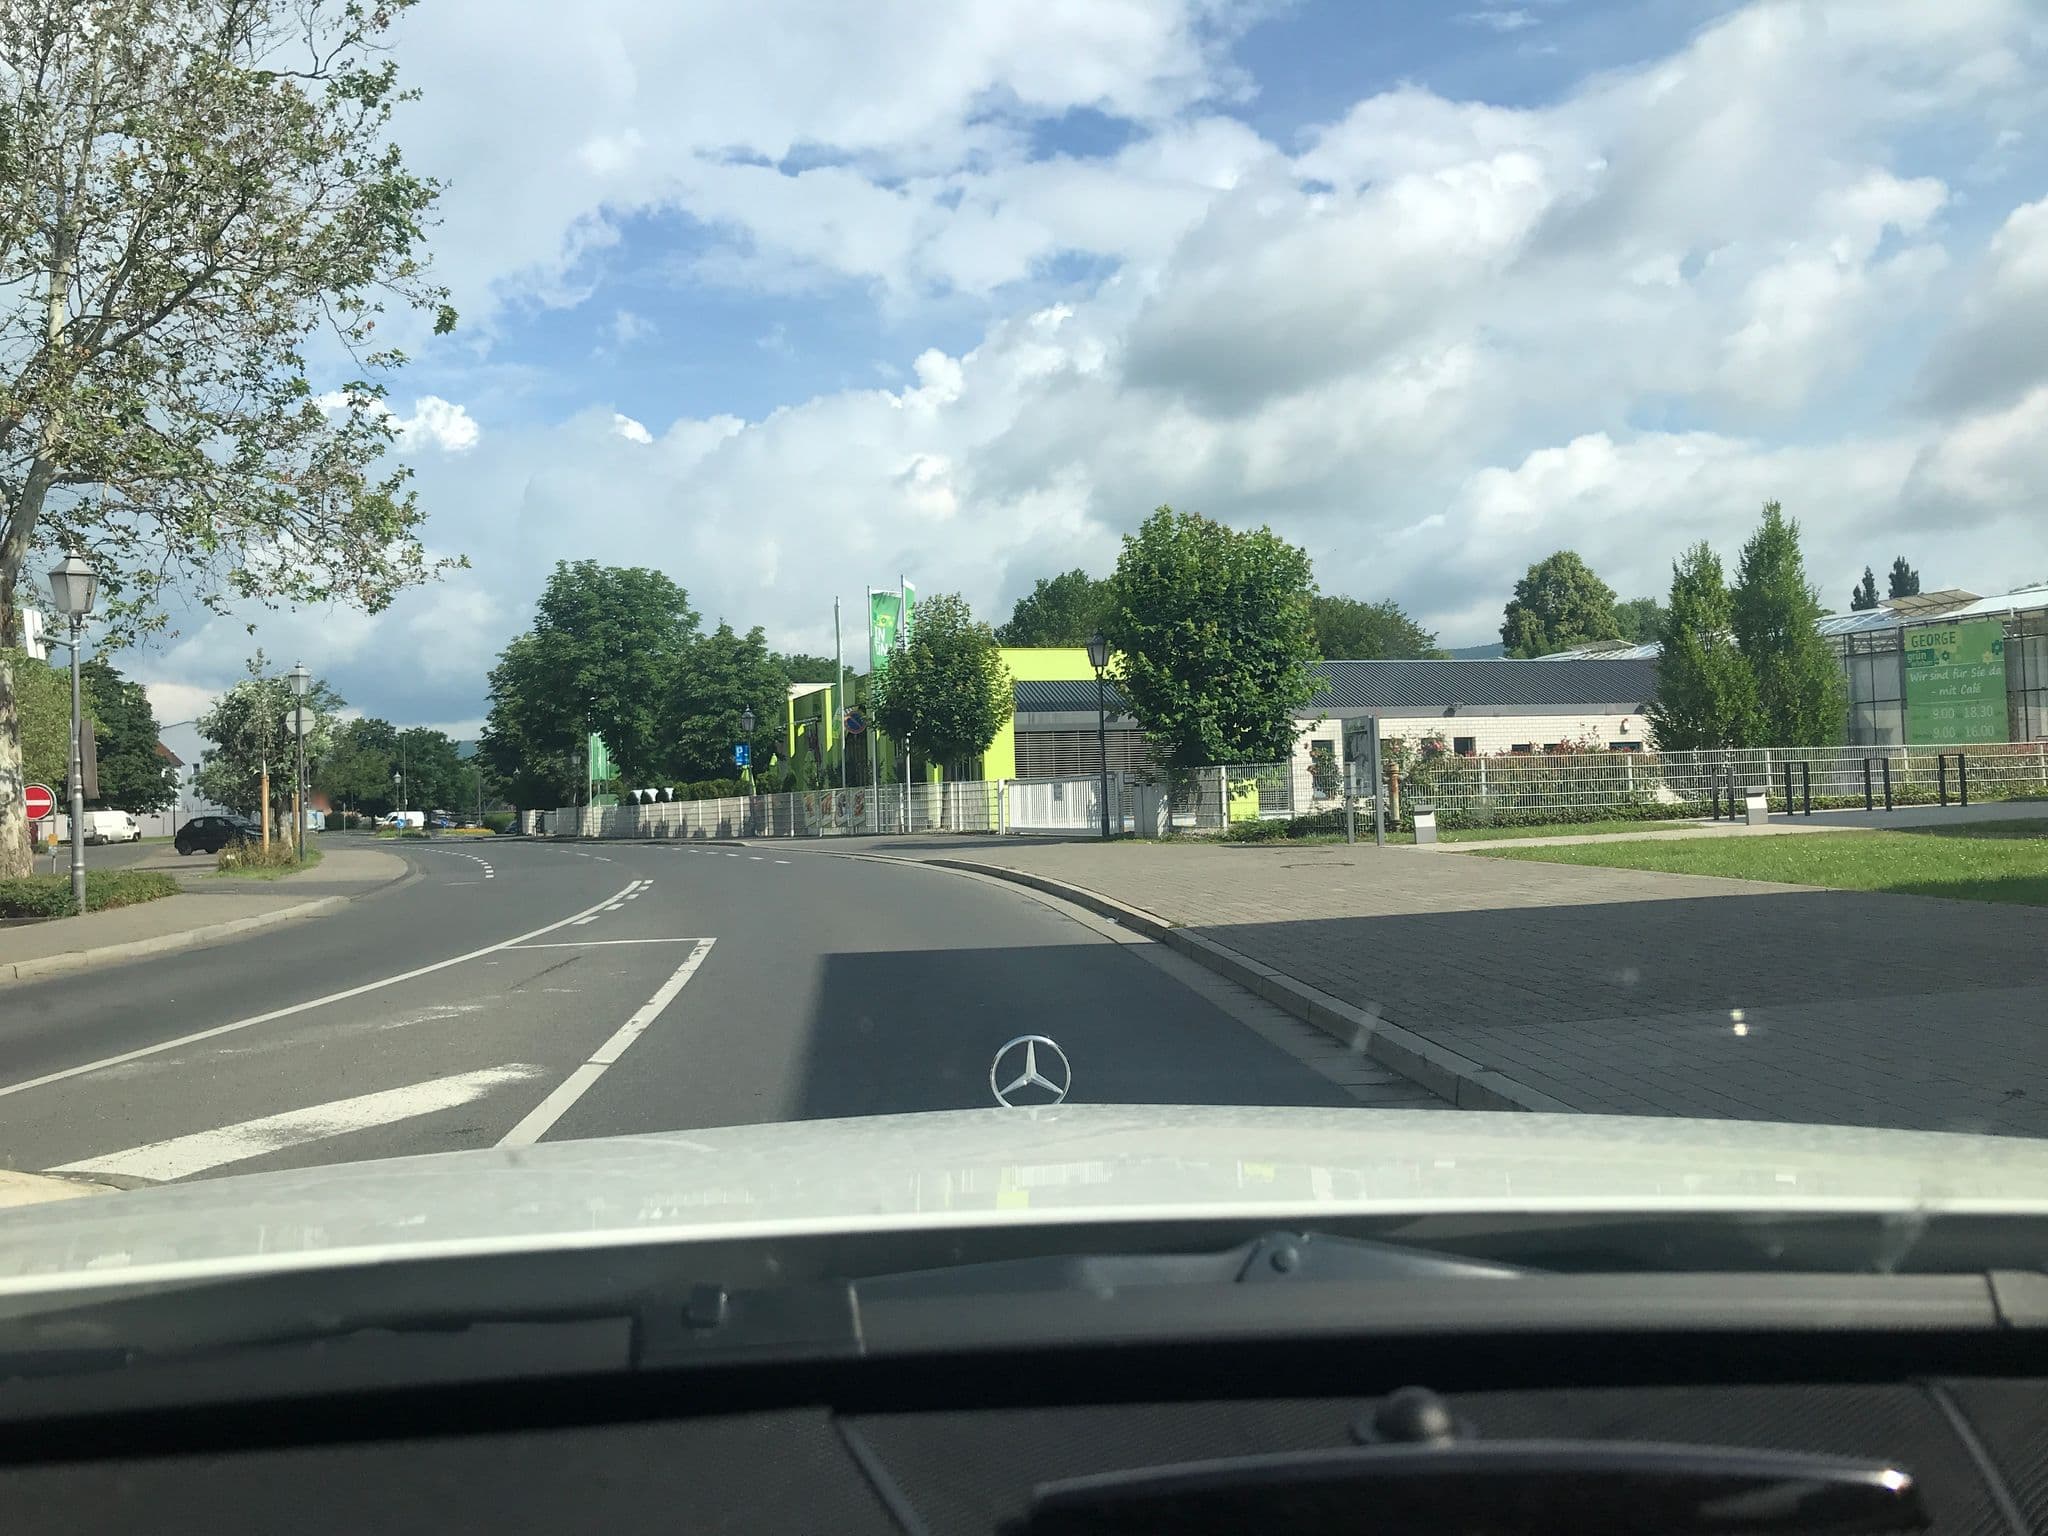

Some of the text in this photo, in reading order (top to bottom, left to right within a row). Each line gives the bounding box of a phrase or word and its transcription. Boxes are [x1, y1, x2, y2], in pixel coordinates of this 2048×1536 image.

[1911, 631, 1956, 648] GEORGE
[1910, 666, 2001, 682] Wir sind für Sie da
[1938, 685, 1957, 696] mit
